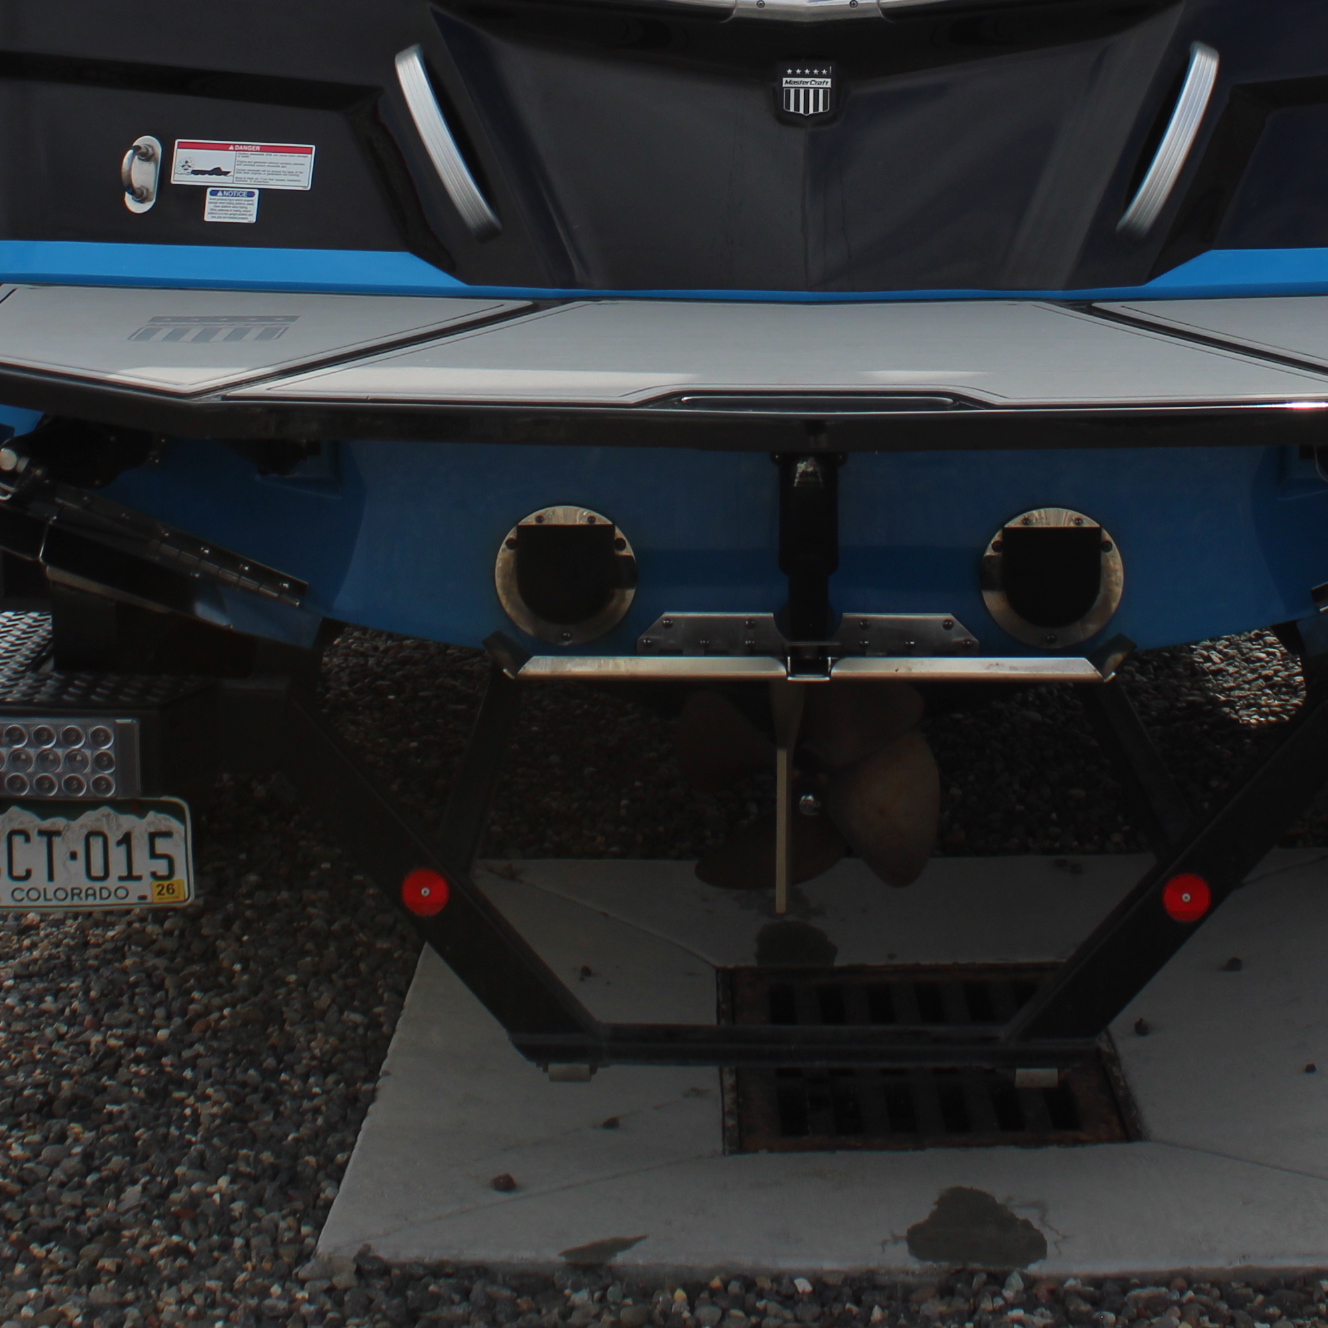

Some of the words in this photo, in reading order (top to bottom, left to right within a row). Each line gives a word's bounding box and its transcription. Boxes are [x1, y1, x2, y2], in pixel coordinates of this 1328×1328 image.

[223, 190, 247, 198] NOTICE
[11, 886, 130, 902] COLORADO
[156, 883, 176, 896] 26
